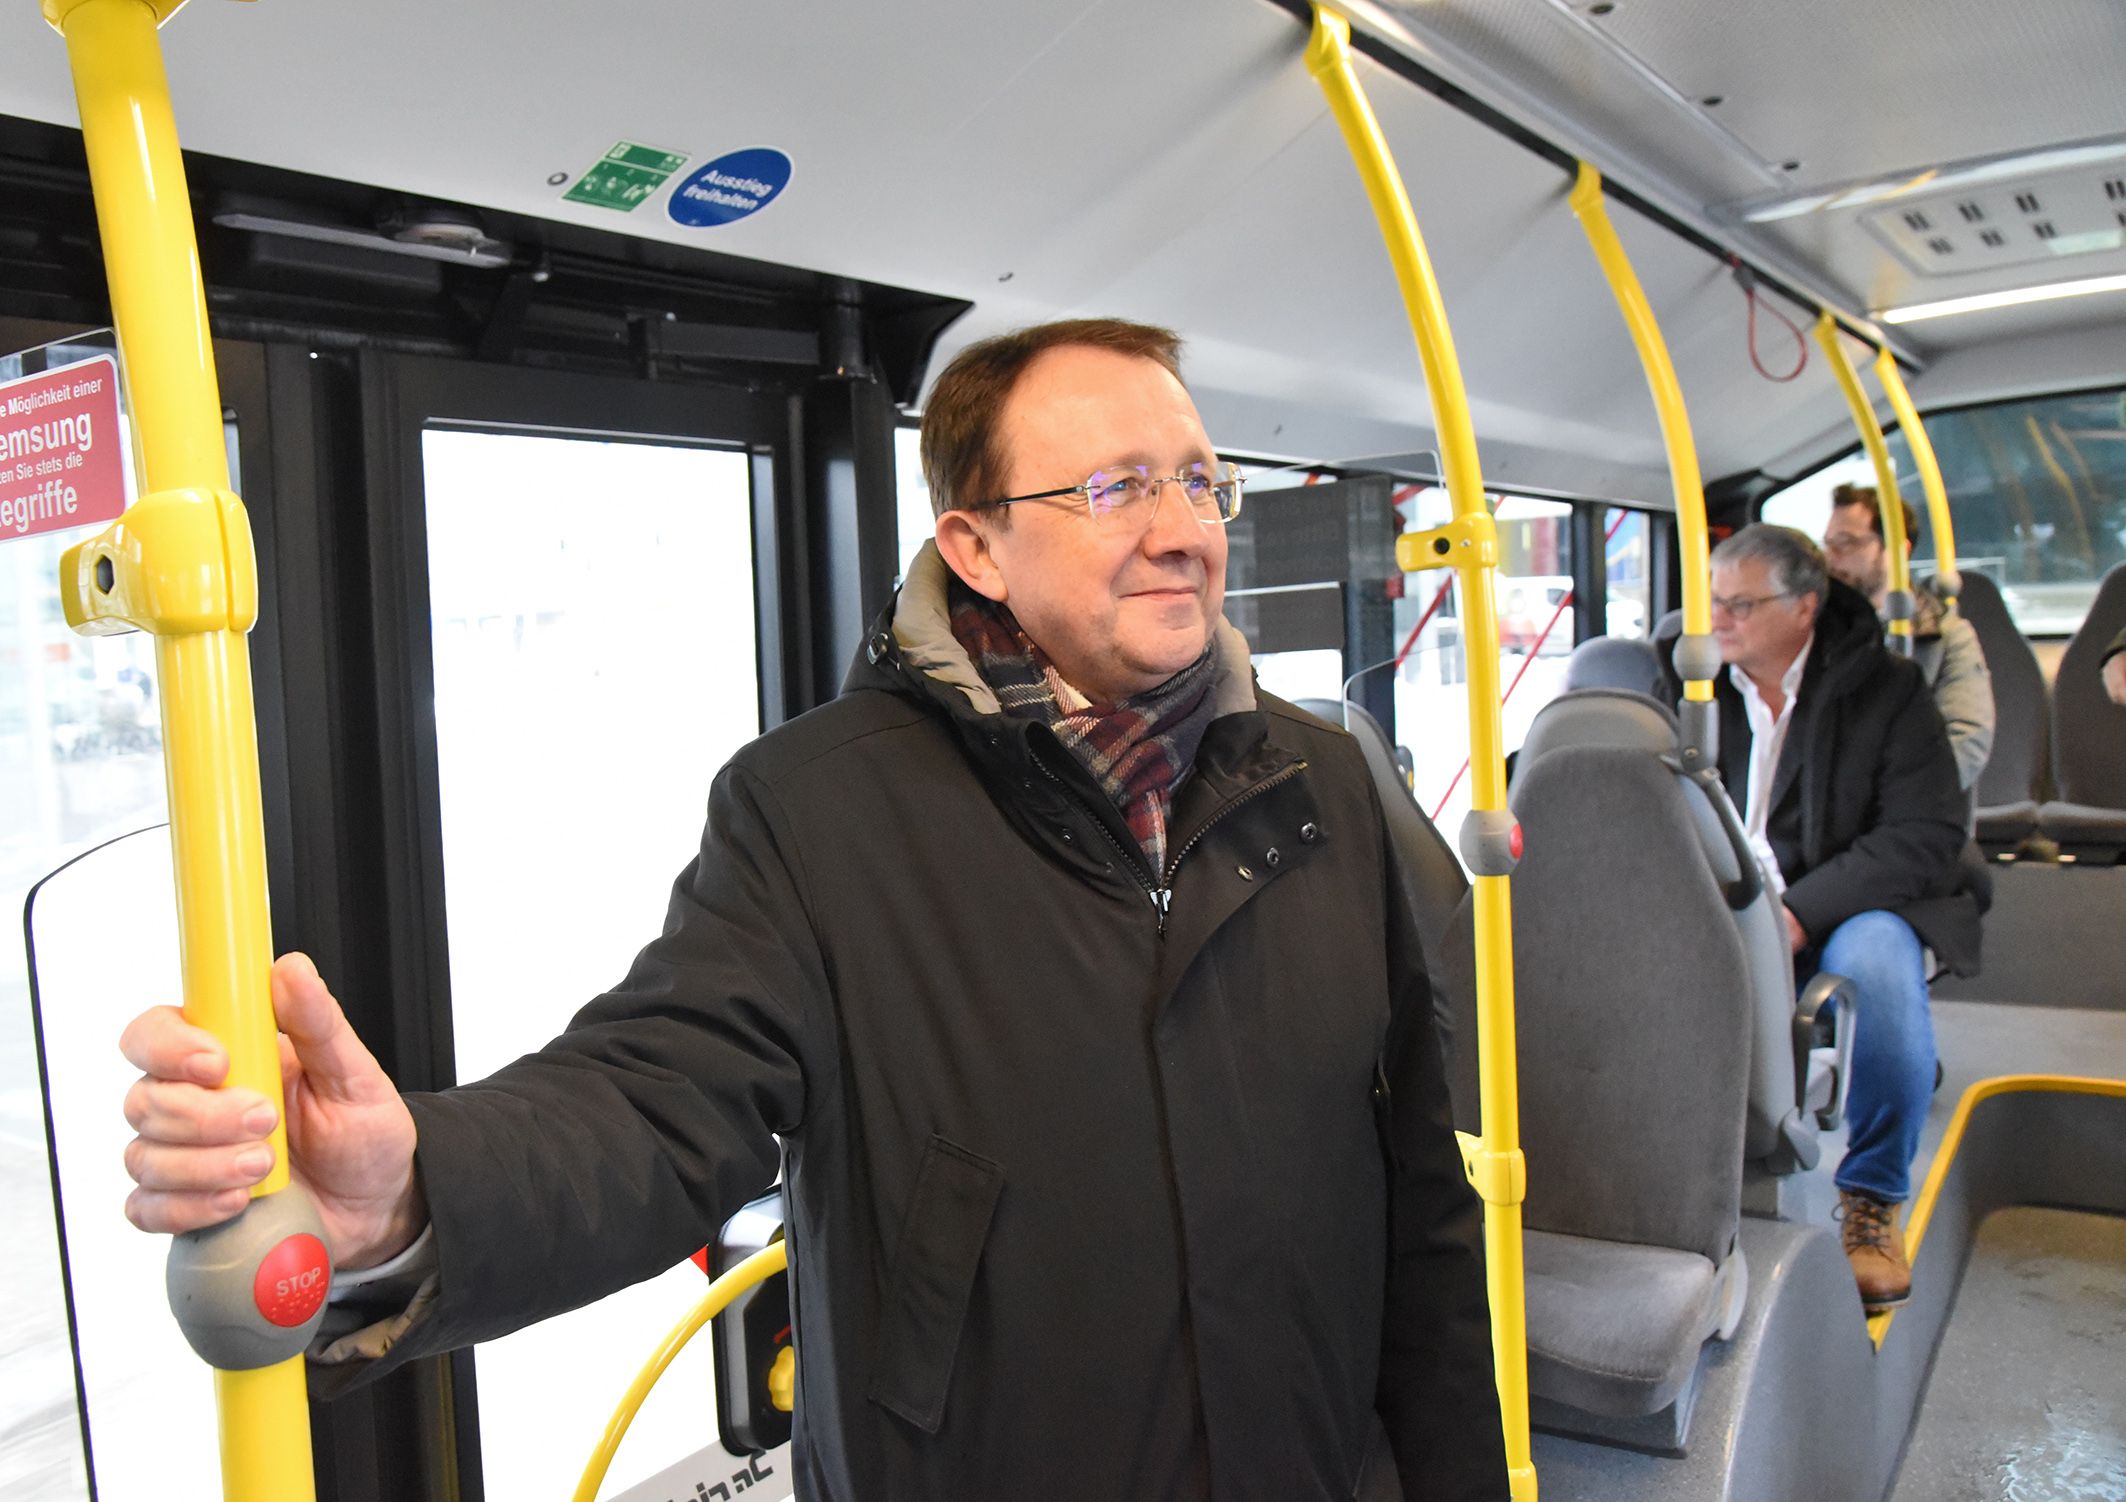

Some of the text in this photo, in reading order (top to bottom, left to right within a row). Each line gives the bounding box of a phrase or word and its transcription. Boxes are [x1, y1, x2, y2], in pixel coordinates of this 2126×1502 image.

[681, 183, 759, 210] freihalten
[699, 168, 773, 198] Ausstieg
[8, 384, 71, 415] Möglichkeit
[73, 378, 103, 399] einer
[16, 462, 34, 481] Sie
[35, 456, 63, 476] stets
[65, 451, 84, 470] die
[275, 1266, 321, 1297] STOP
